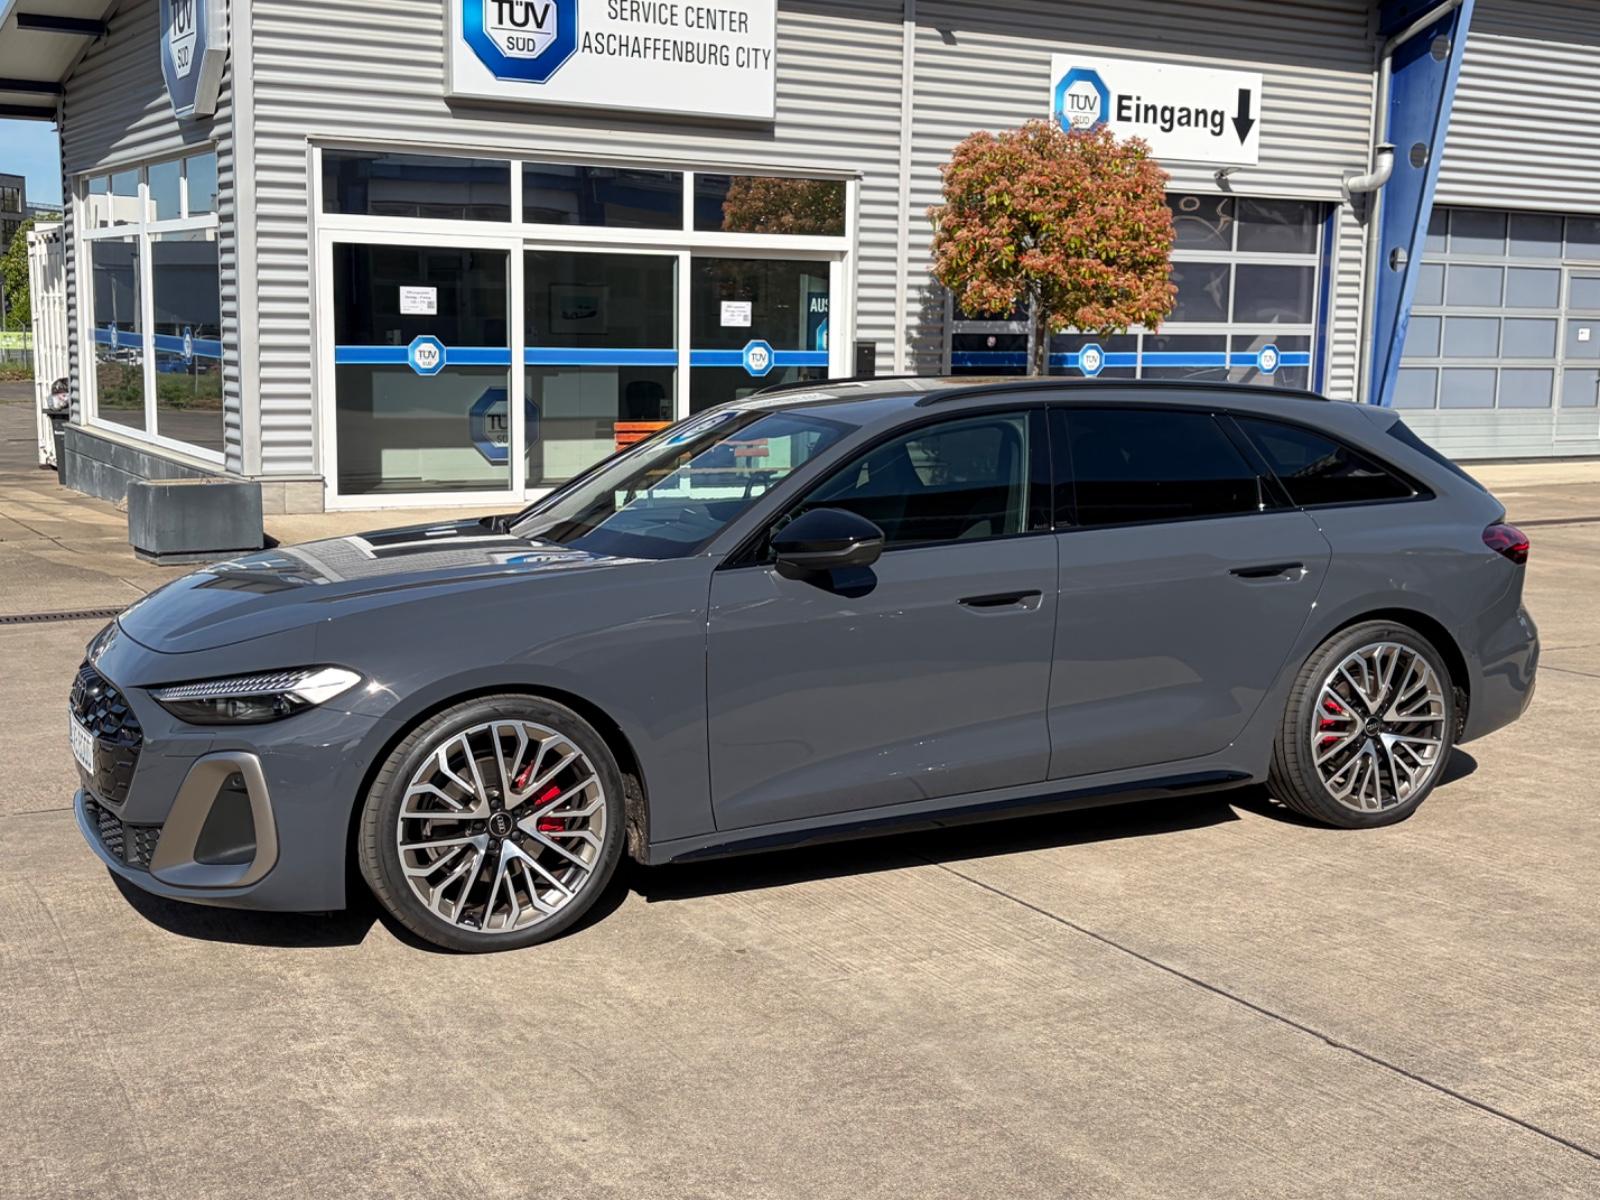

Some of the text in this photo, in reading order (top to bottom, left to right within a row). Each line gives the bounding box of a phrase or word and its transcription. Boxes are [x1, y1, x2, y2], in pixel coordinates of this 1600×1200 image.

[491, 0, 551, 29] TÜV
[607, 0, 749, 33] SERVICE CENTER
[506, 36, 536, 53] SÜD
[581, 31, 771, 71] ASCHAFFENBURG CITY
[1068, 93, 1098, 112] TÜV
[1116, 94, 1225, 137] Eingang
